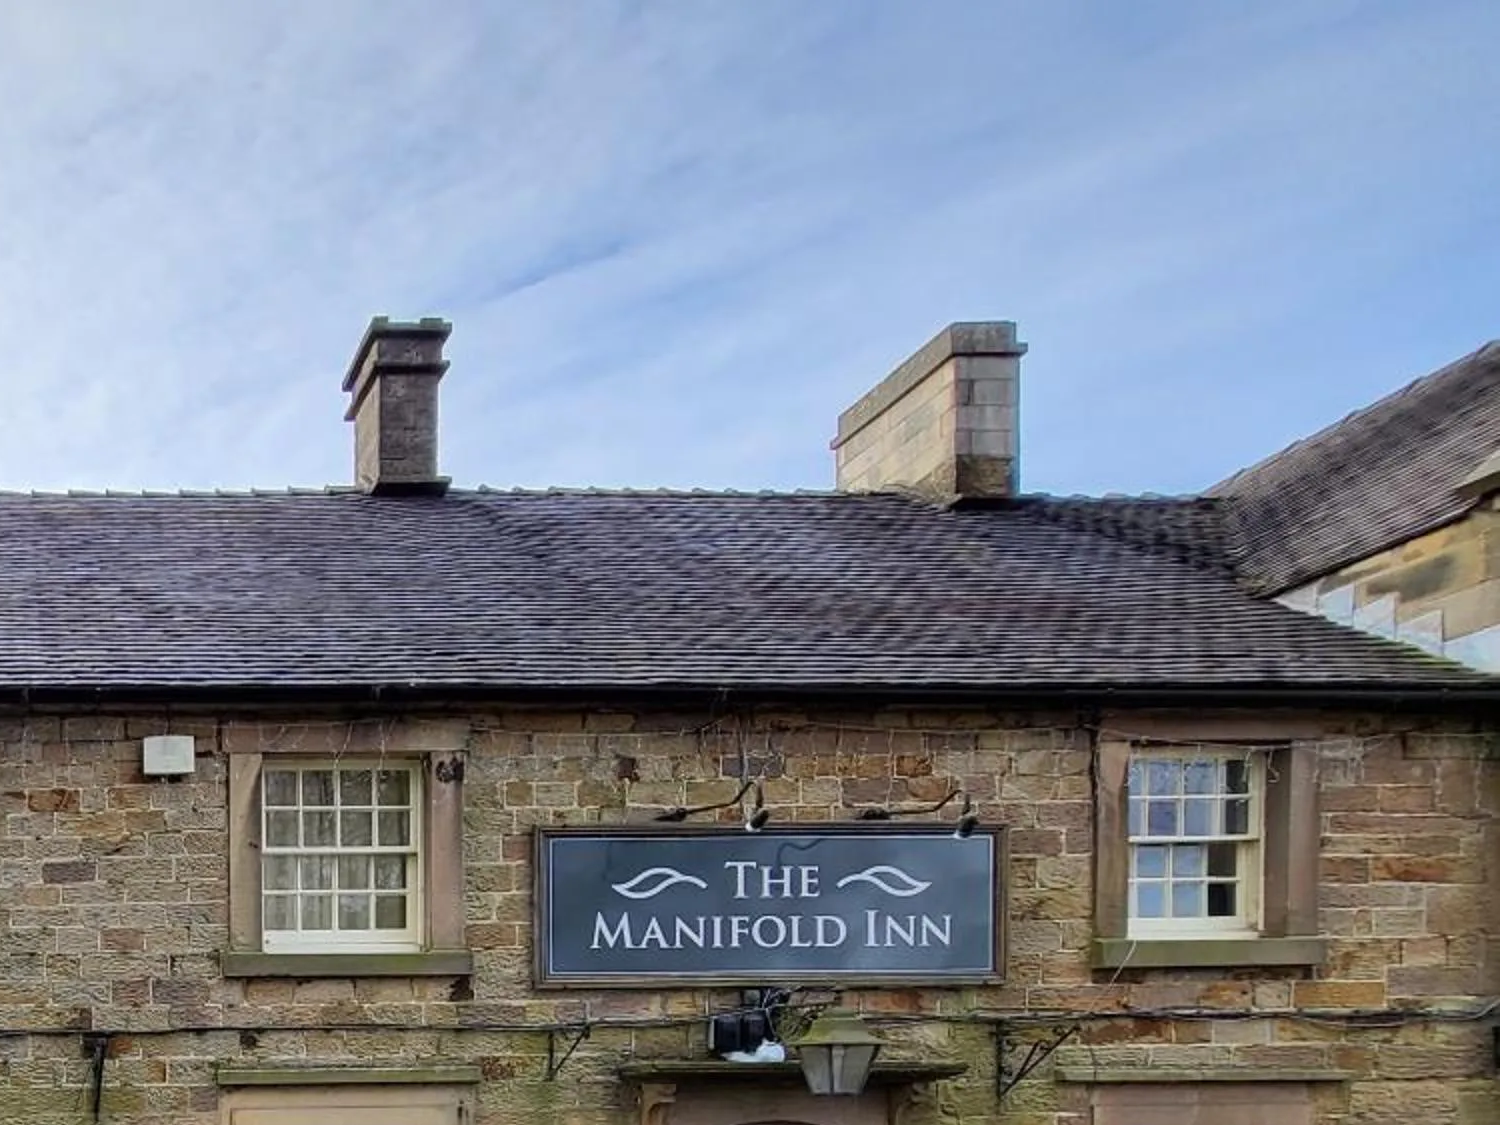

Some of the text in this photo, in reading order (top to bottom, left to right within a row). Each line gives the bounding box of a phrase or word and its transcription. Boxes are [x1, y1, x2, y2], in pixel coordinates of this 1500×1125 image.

[724, 861, 821, 898] THE
[589, 909, 952, 950] MANIFOLD INN
